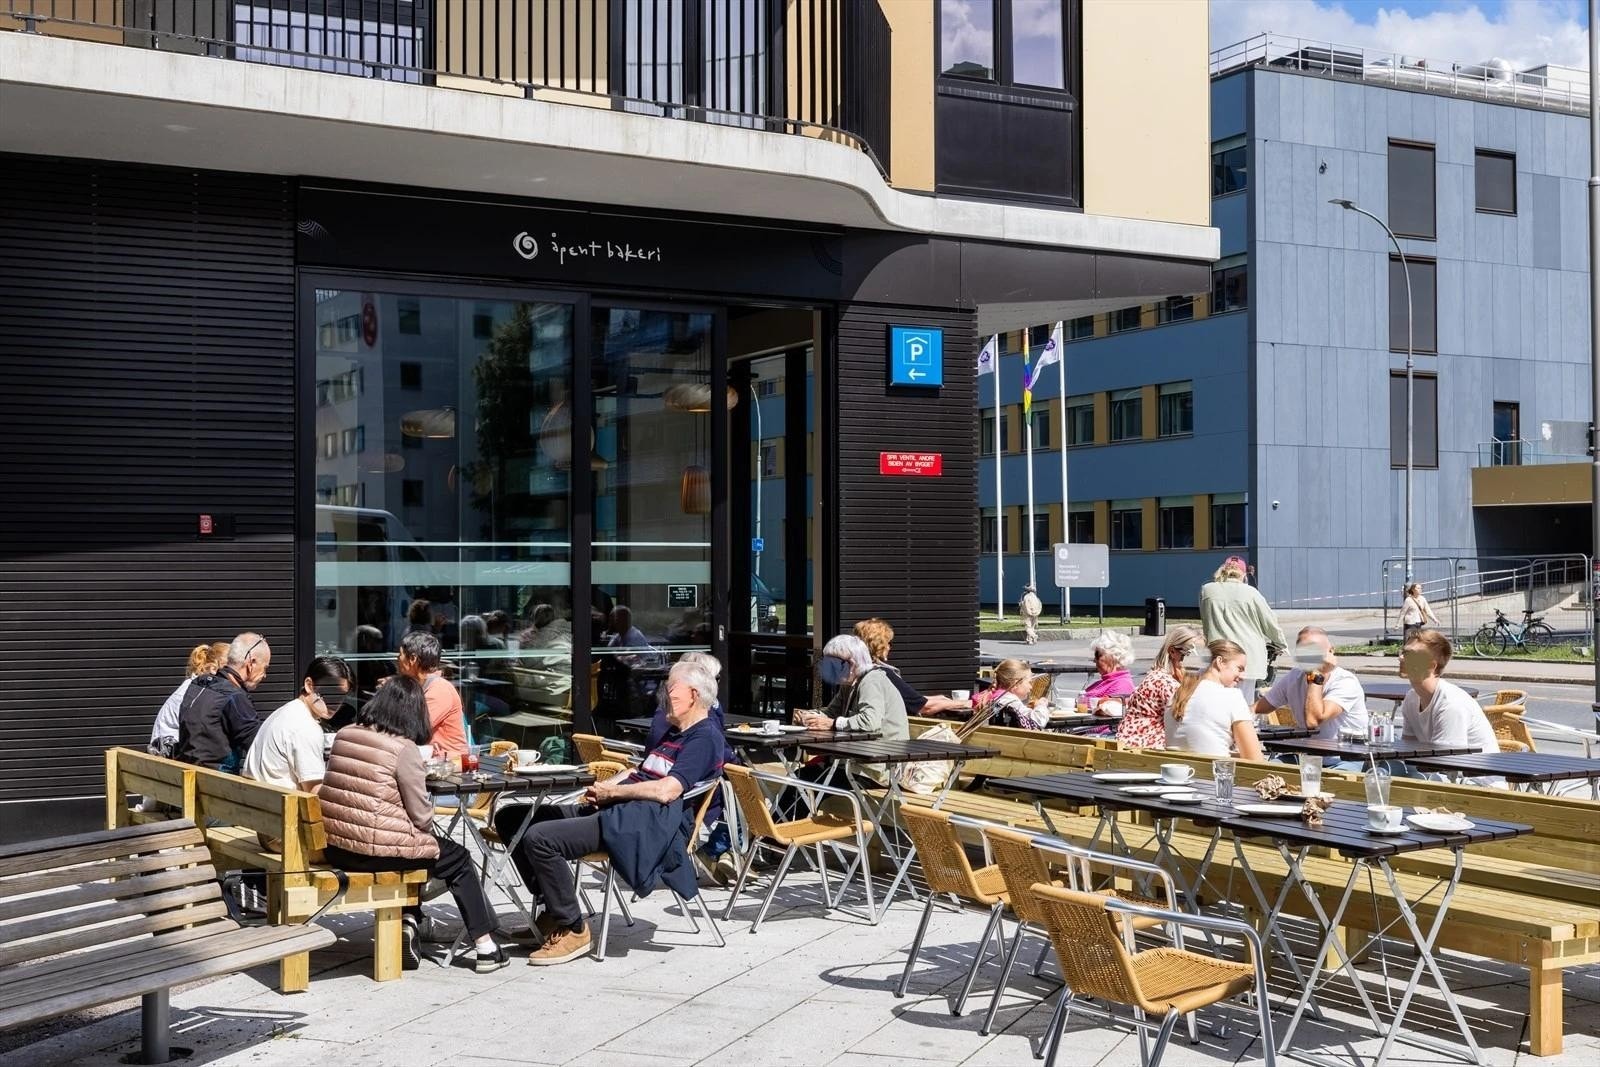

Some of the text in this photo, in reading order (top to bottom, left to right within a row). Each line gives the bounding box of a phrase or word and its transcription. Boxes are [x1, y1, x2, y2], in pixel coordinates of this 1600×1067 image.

[551, 232, 661, 264] åpent bakeri
[911, 344, 923, 361] P
